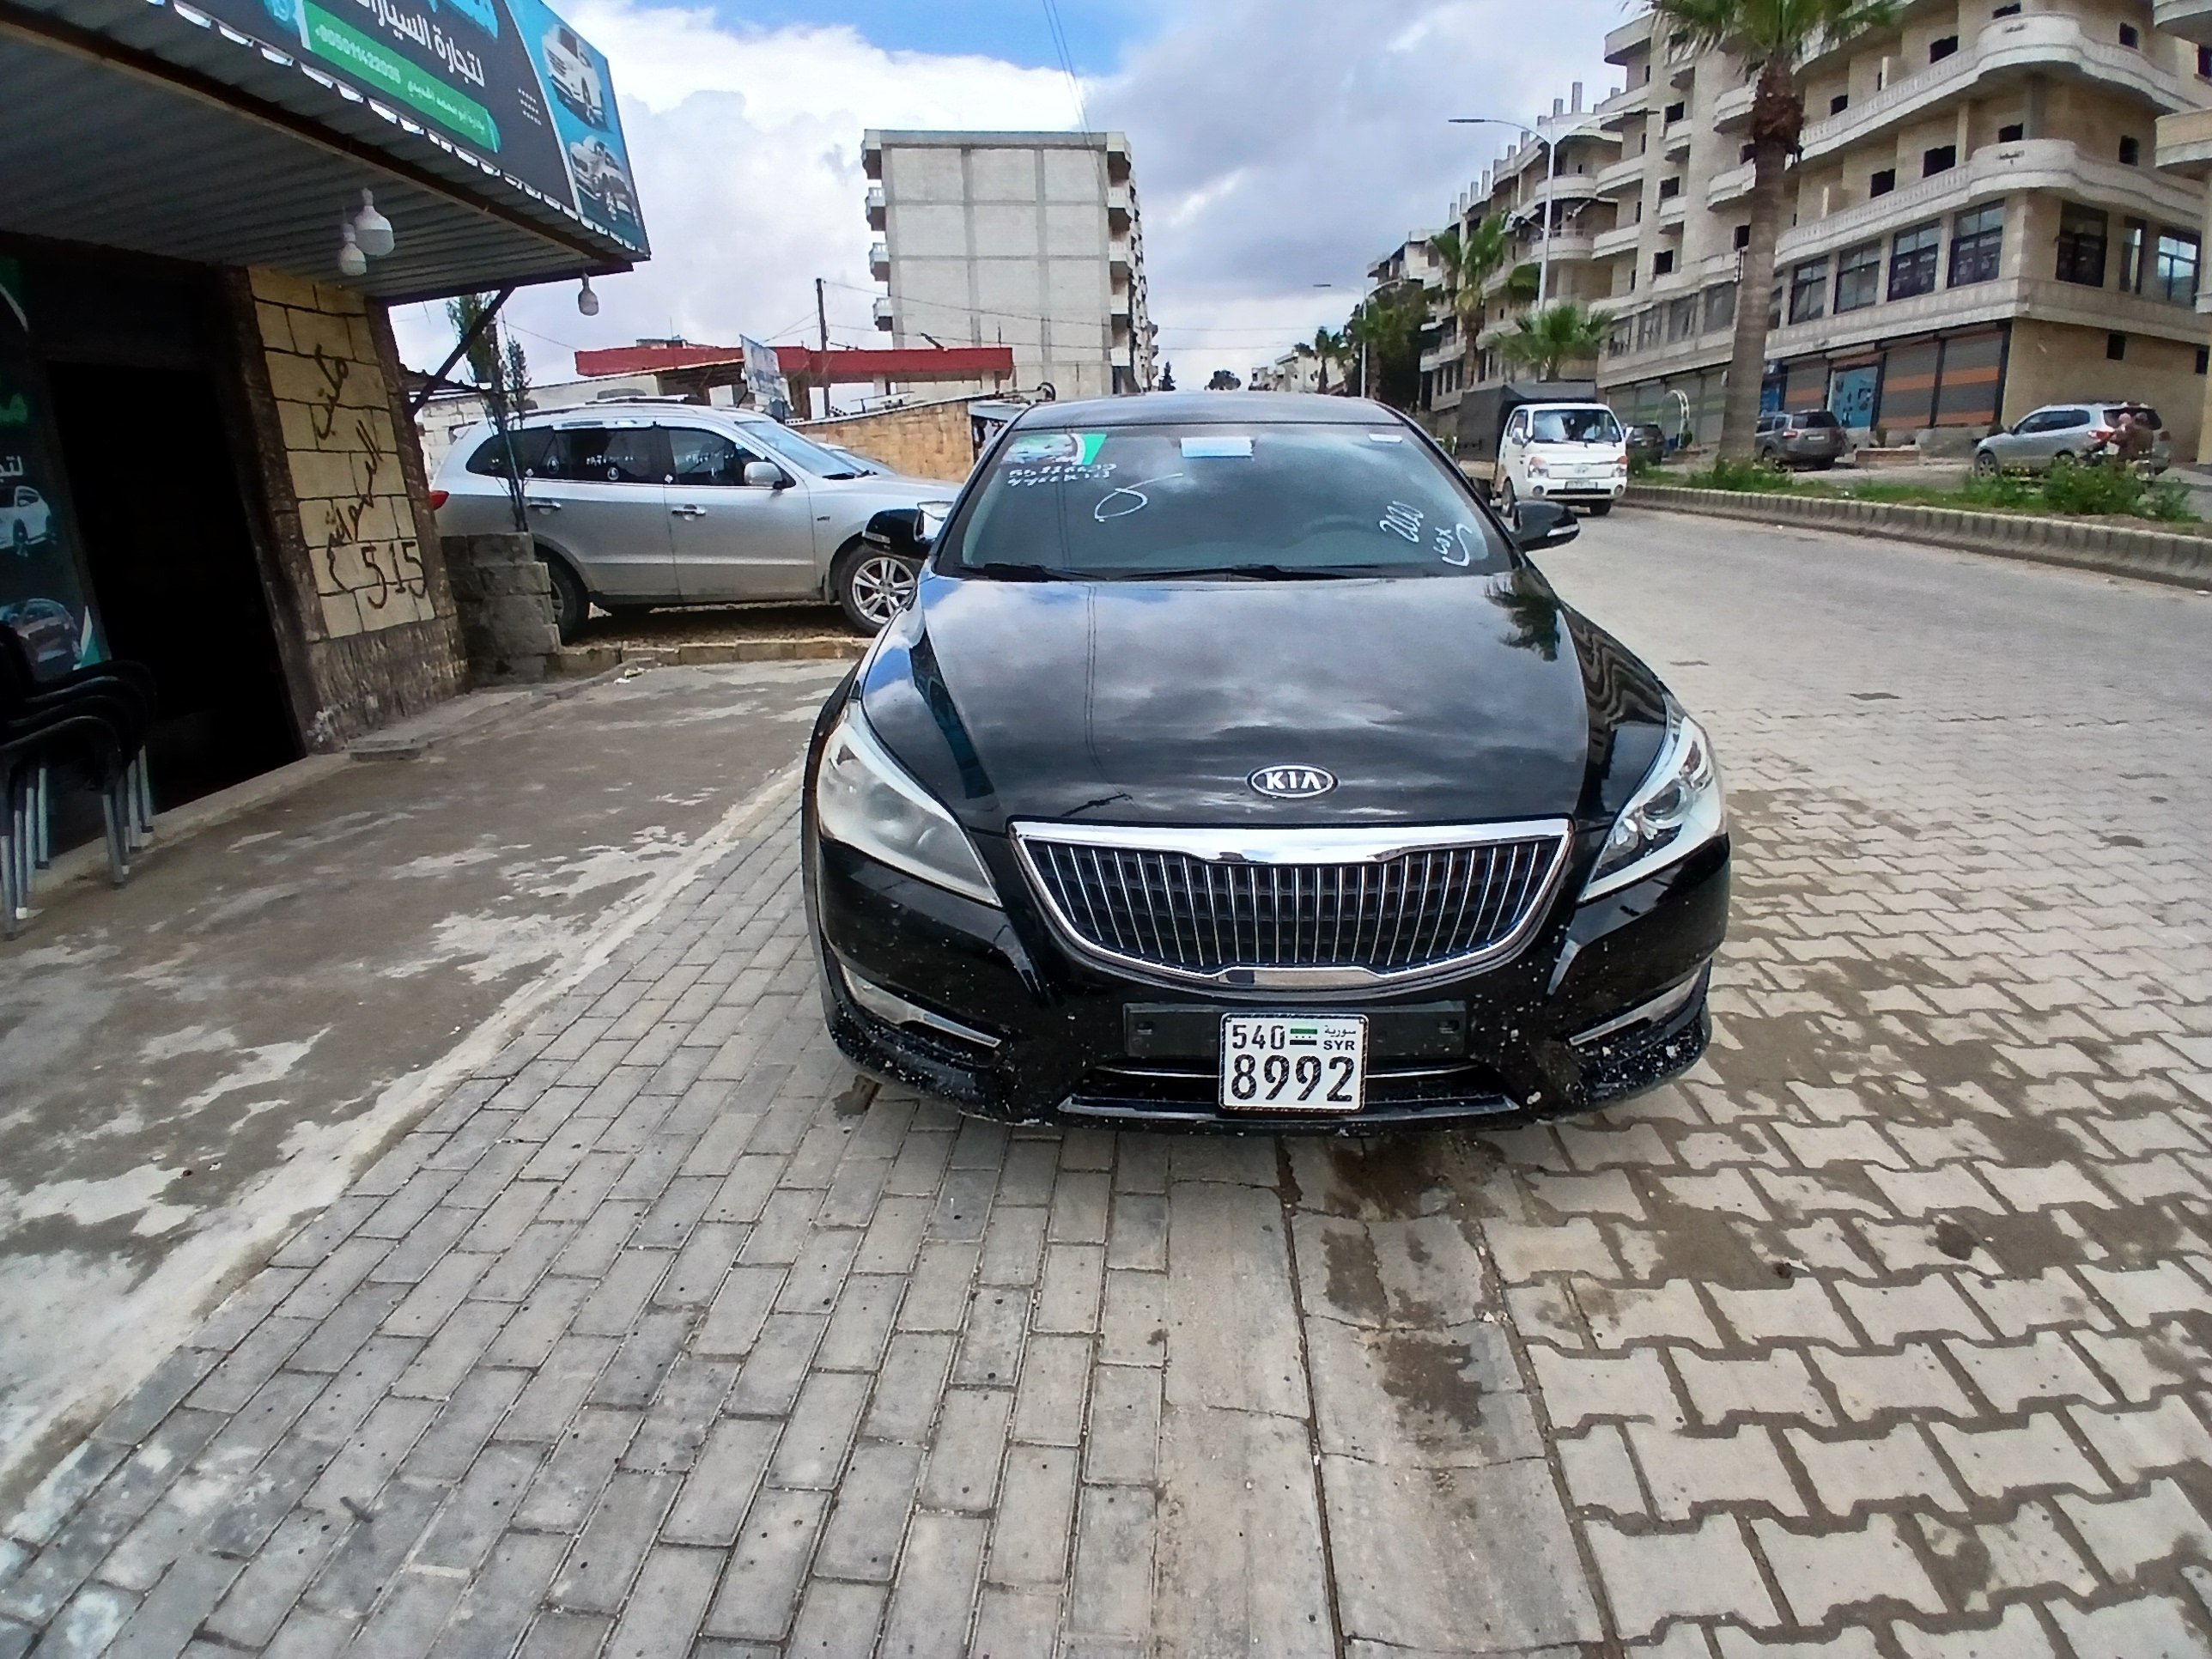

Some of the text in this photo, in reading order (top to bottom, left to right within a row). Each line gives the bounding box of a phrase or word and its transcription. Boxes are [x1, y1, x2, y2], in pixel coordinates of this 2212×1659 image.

[432, 24, 485, 88] لتجارة
[1265, 771, 1322, 789] KIA
[1231, 1024, 1285, 1050] 540
[1324, 1024, 1357, 1038] سورية
[1323, 1039, 1355, 1051] SYR
[1231, 1054, 1355, 1102] 8992
